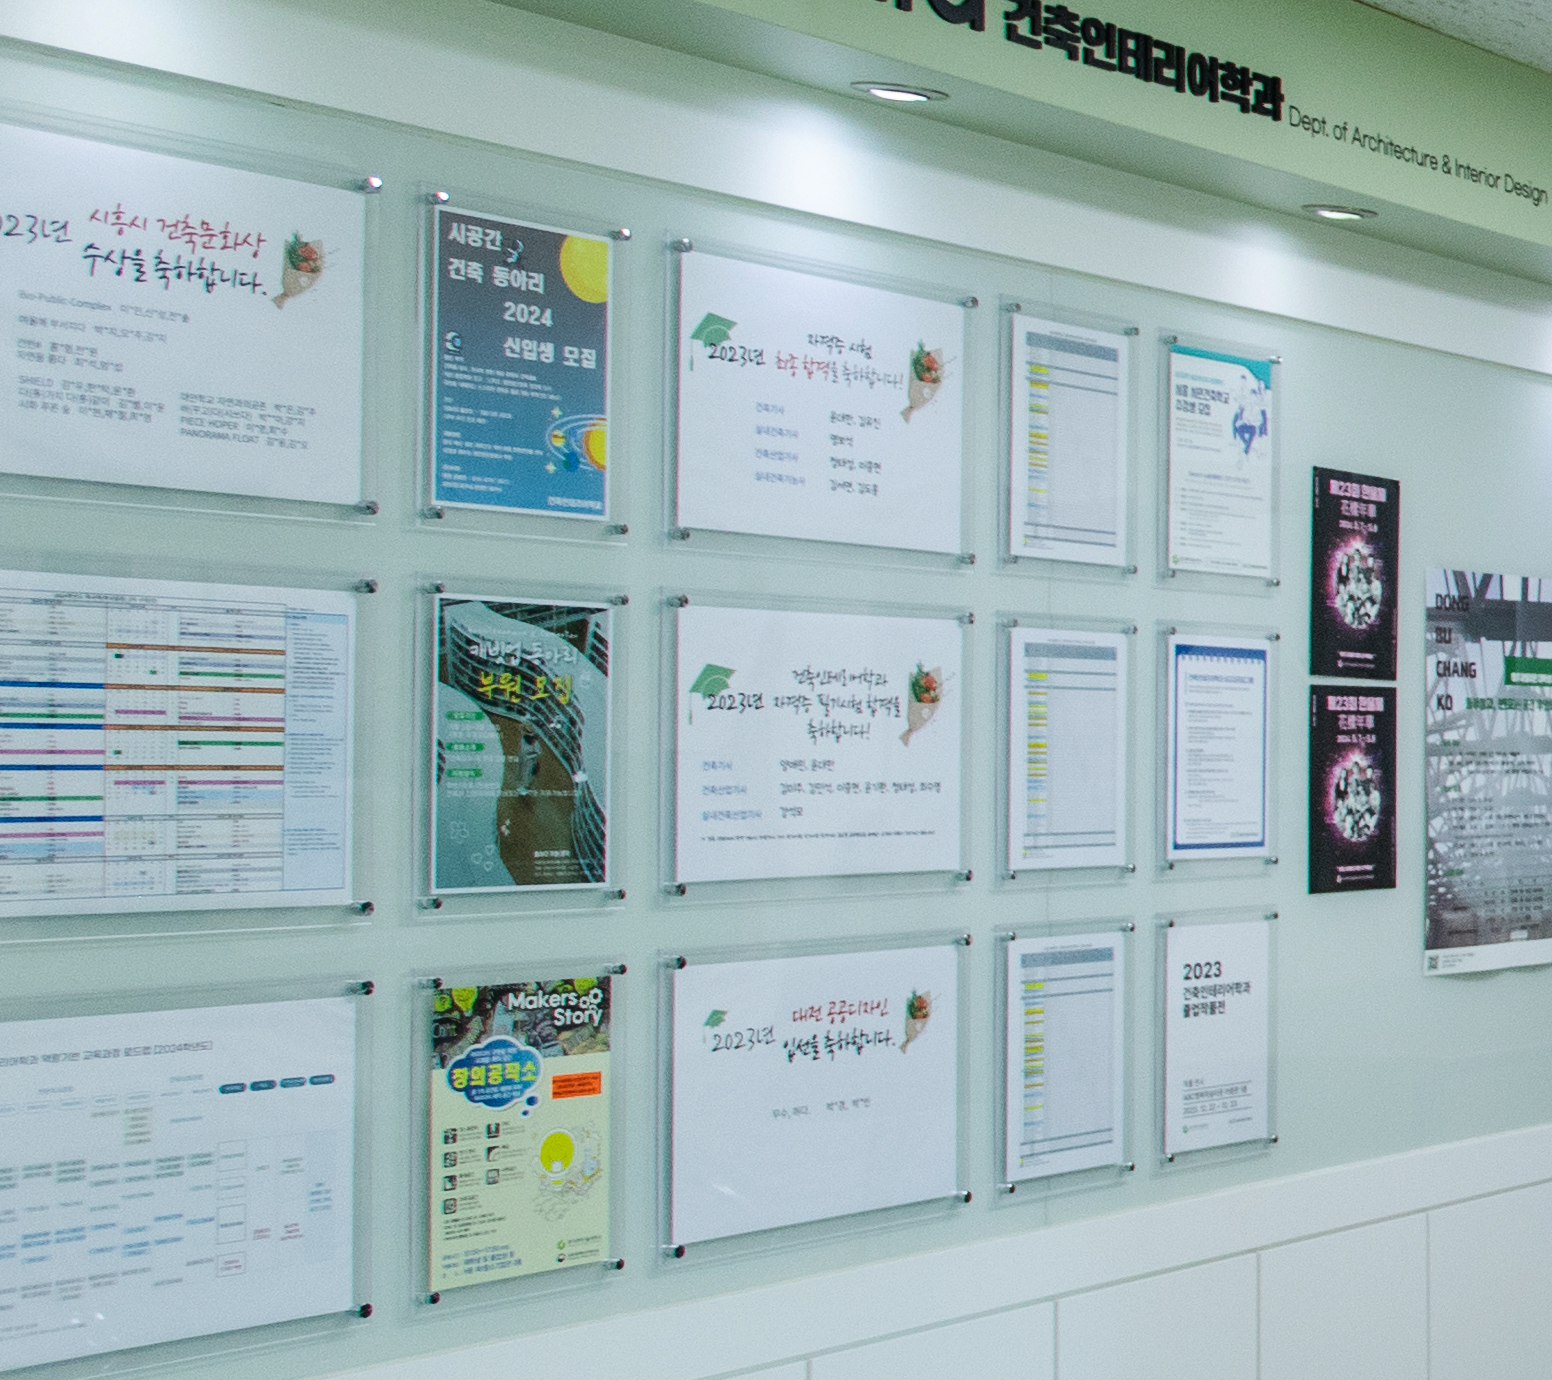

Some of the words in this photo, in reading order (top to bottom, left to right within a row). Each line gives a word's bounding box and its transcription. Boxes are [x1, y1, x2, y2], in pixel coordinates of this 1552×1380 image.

[1289, 105, 1328, 138] Dept.
[1333, 122, 1348, 140] of
[1351, 127, 1438, 170] Architecture
[1442, 155, 1452, 175] &
[1455, 158, 1501, 189] Interior
[1504, 174, 1548, 207] Design
[0, 214, 73, 245] 23년
[89, 202, 148, 236] 시흥시
[156, 213, 267, 259] 건축문화상
[448, 222, 502, 252] 시공간
[82, 243, 148, 283] 수상을
[154, 249, 267, 297] 축하합니다.
[447, 258, 484, 284] 건축
[492, 265, 545, 294] 동아리
[503, 301, 553, 327] 2024
[503, 336, 555, 364] 신입생
[563, 346, 596, 370] 모집
[707, 343, 765, 367] 2023년
[807, 334, 846, 355] 자격증
[849, 340, 872, 360] 시험
[1435, 593, 1470, 612] DONG
[1435, 627, 1452, 644] BU
[1437, 660, 1476, 678] CHANG
[706, 693, 765, 714] 2023년
[1437, 694, 1452, 711] KO
[1183, 961, 1222, 981] 2023
[508, 991, 577, 1011] Makers
[1183, 981, 1251, 1001] 건축인테리어학과
[553, 1007, 603, 1027] Story
[711, 1025, 776, 1053] 2023년
